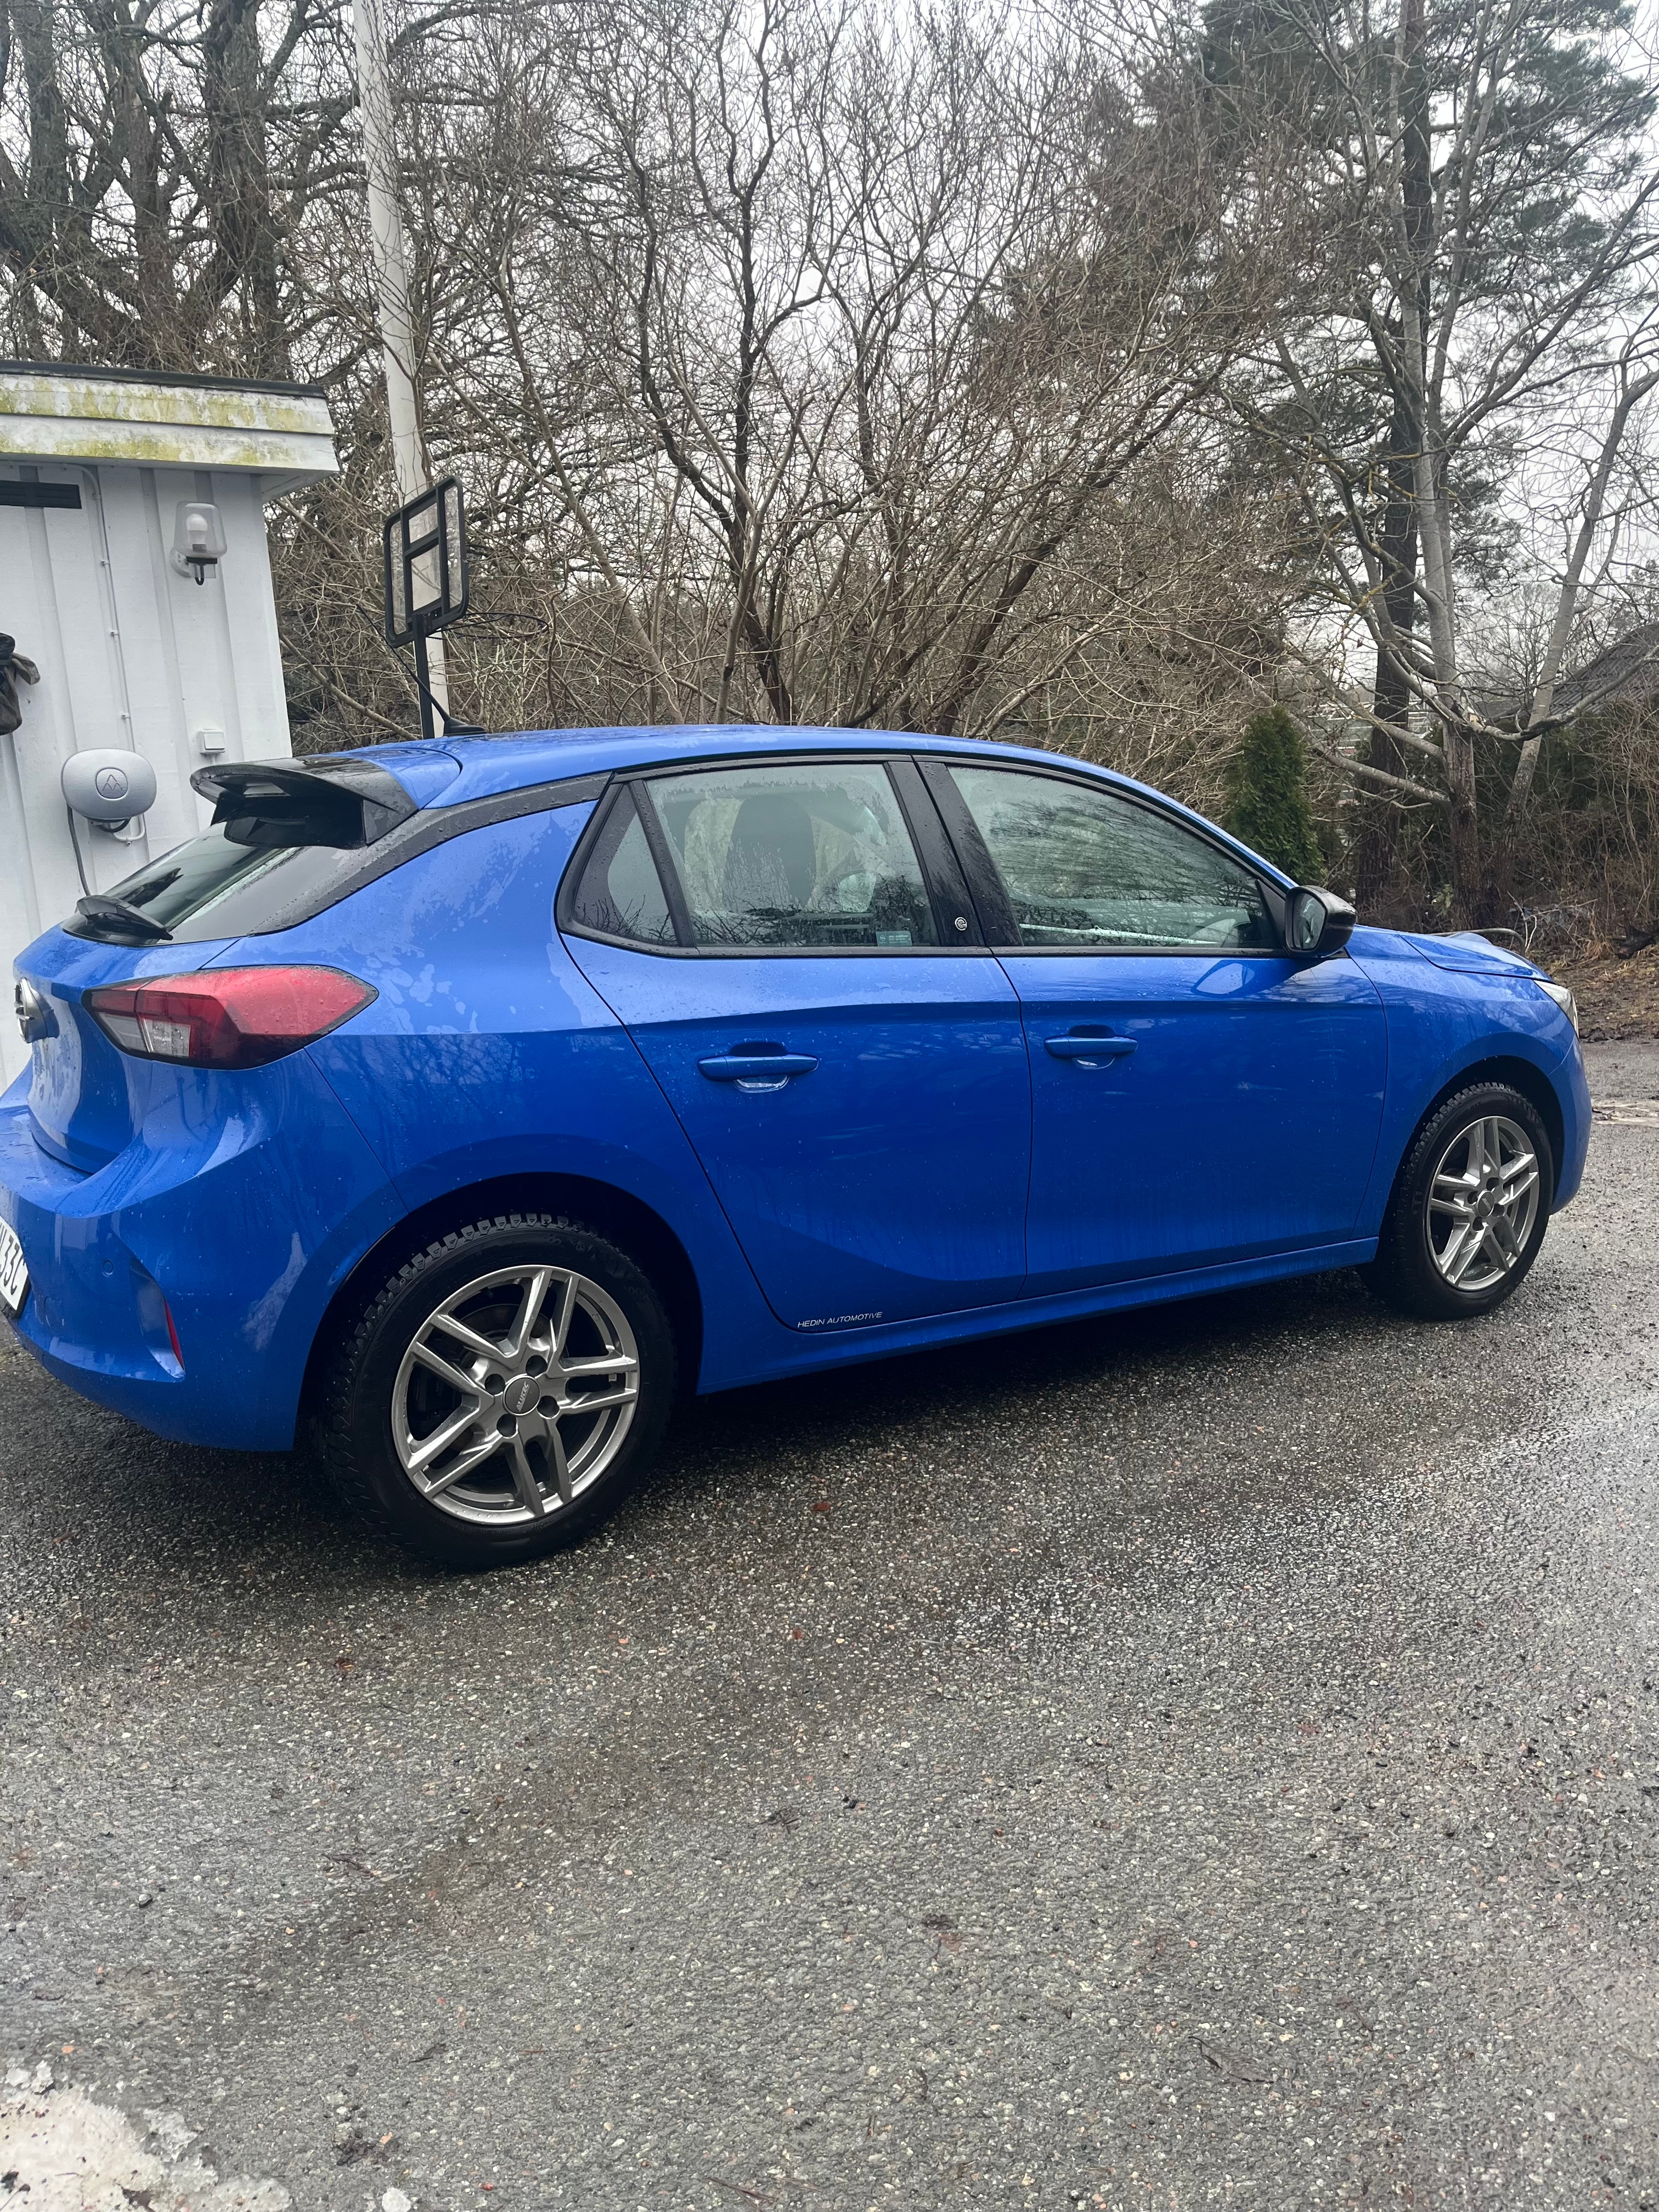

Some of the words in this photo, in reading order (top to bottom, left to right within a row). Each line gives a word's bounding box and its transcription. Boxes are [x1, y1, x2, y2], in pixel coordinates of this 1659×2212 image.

[797, 1319, 825, 1328] HEDIN
[826, 1311, 883, 1324] AUTOMOTIVE
[516, 1380, 531, 1412] ALUTEC
